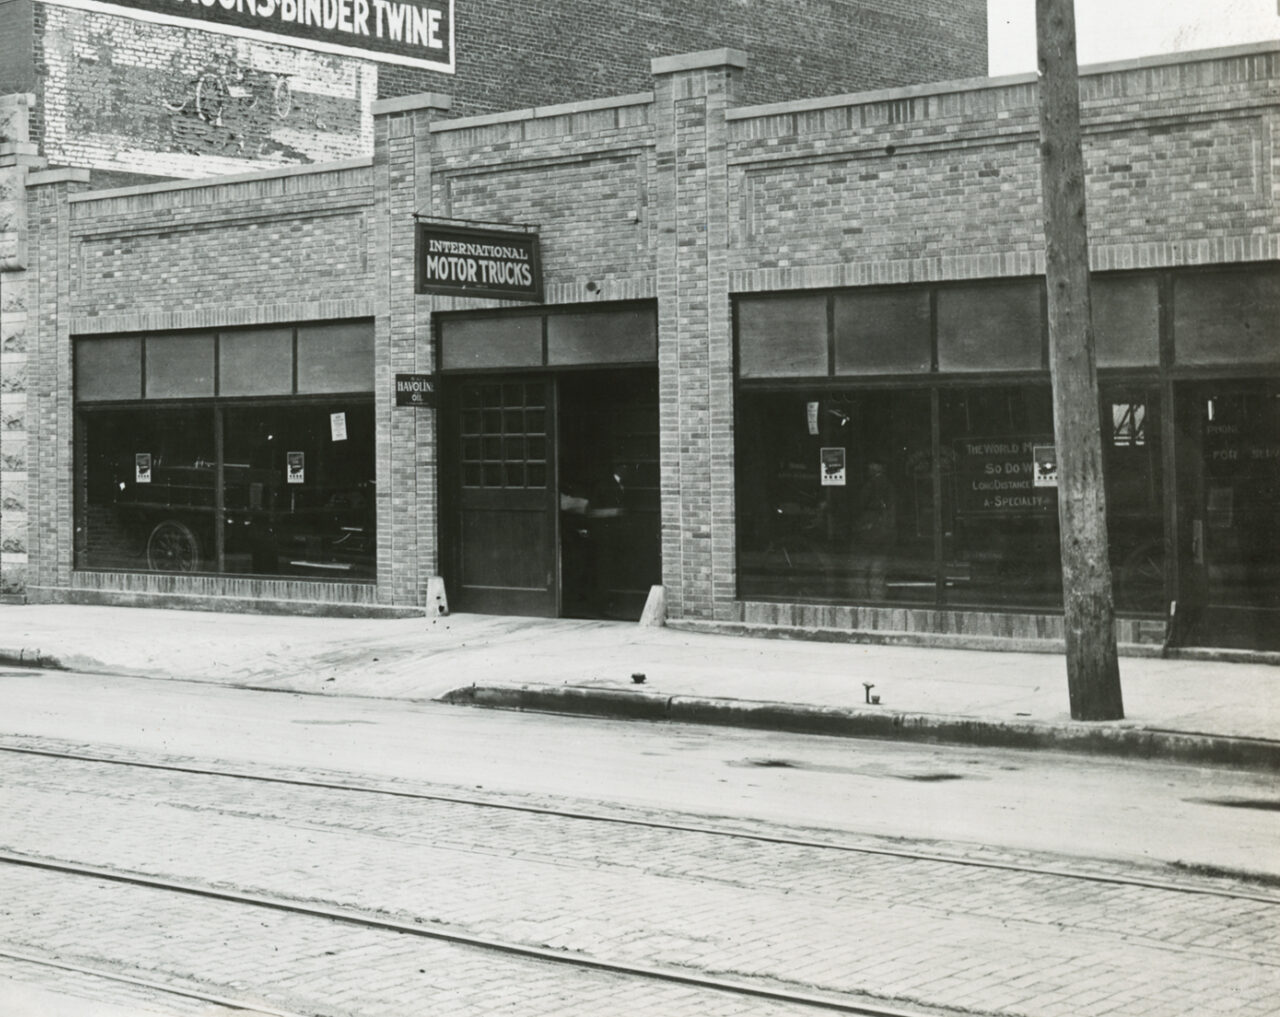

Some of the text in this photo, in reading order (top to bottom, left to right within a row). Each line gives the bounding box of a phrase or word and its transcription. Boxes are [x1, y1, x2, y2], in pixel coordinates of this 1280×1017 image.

[429, 239, 528, 259] INTERNATIONAL
[426, 255, 532, 286] MOTOR TRUCKS
